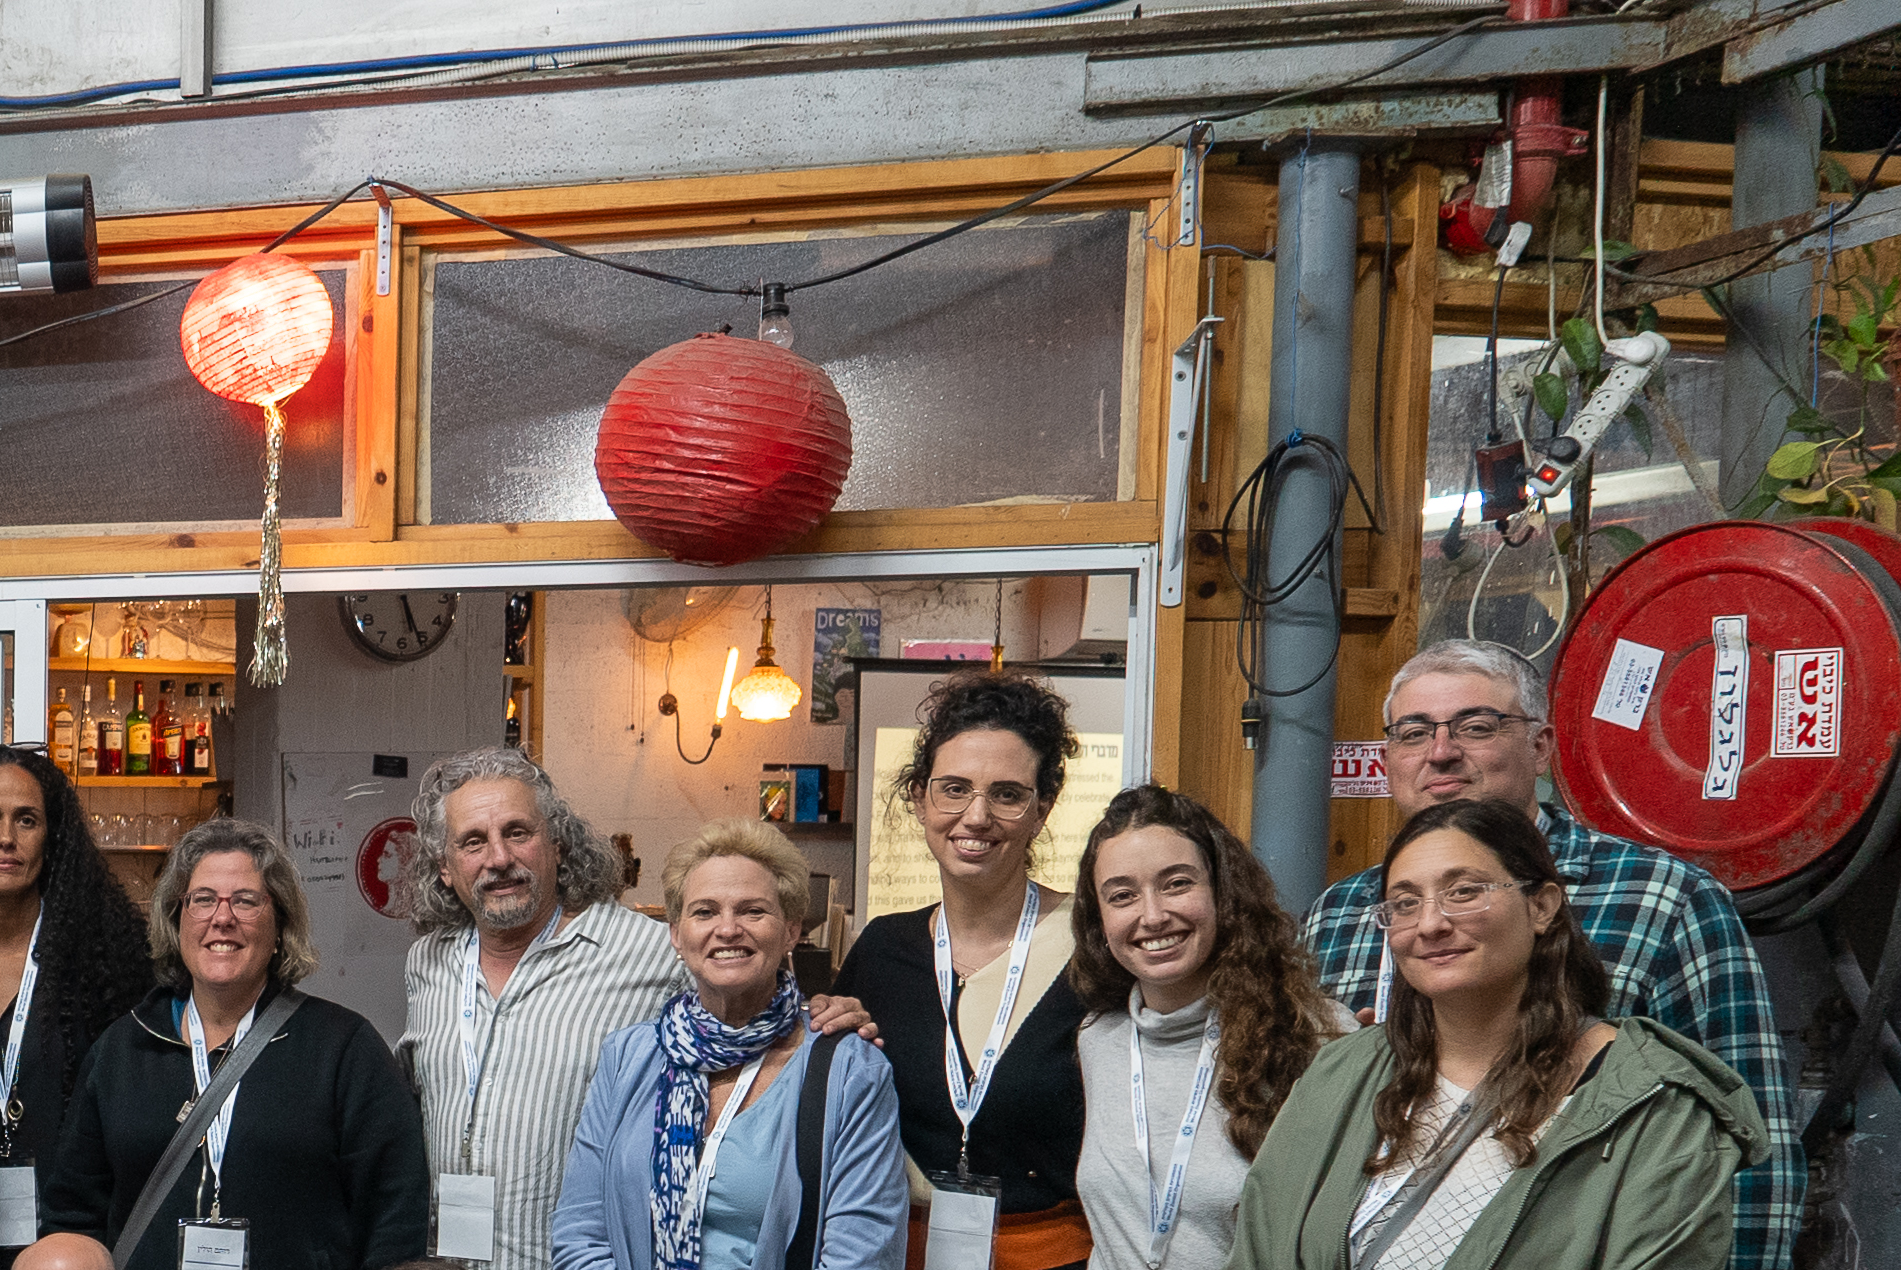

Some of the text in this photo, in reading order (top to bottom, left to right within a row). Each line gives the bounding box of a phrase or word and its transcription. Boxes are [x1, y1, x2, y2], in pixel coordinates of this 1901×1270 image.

[1796, 656, 1819, 749] אש
[1819, 655, 1835, 749] עמדת כיבוי
